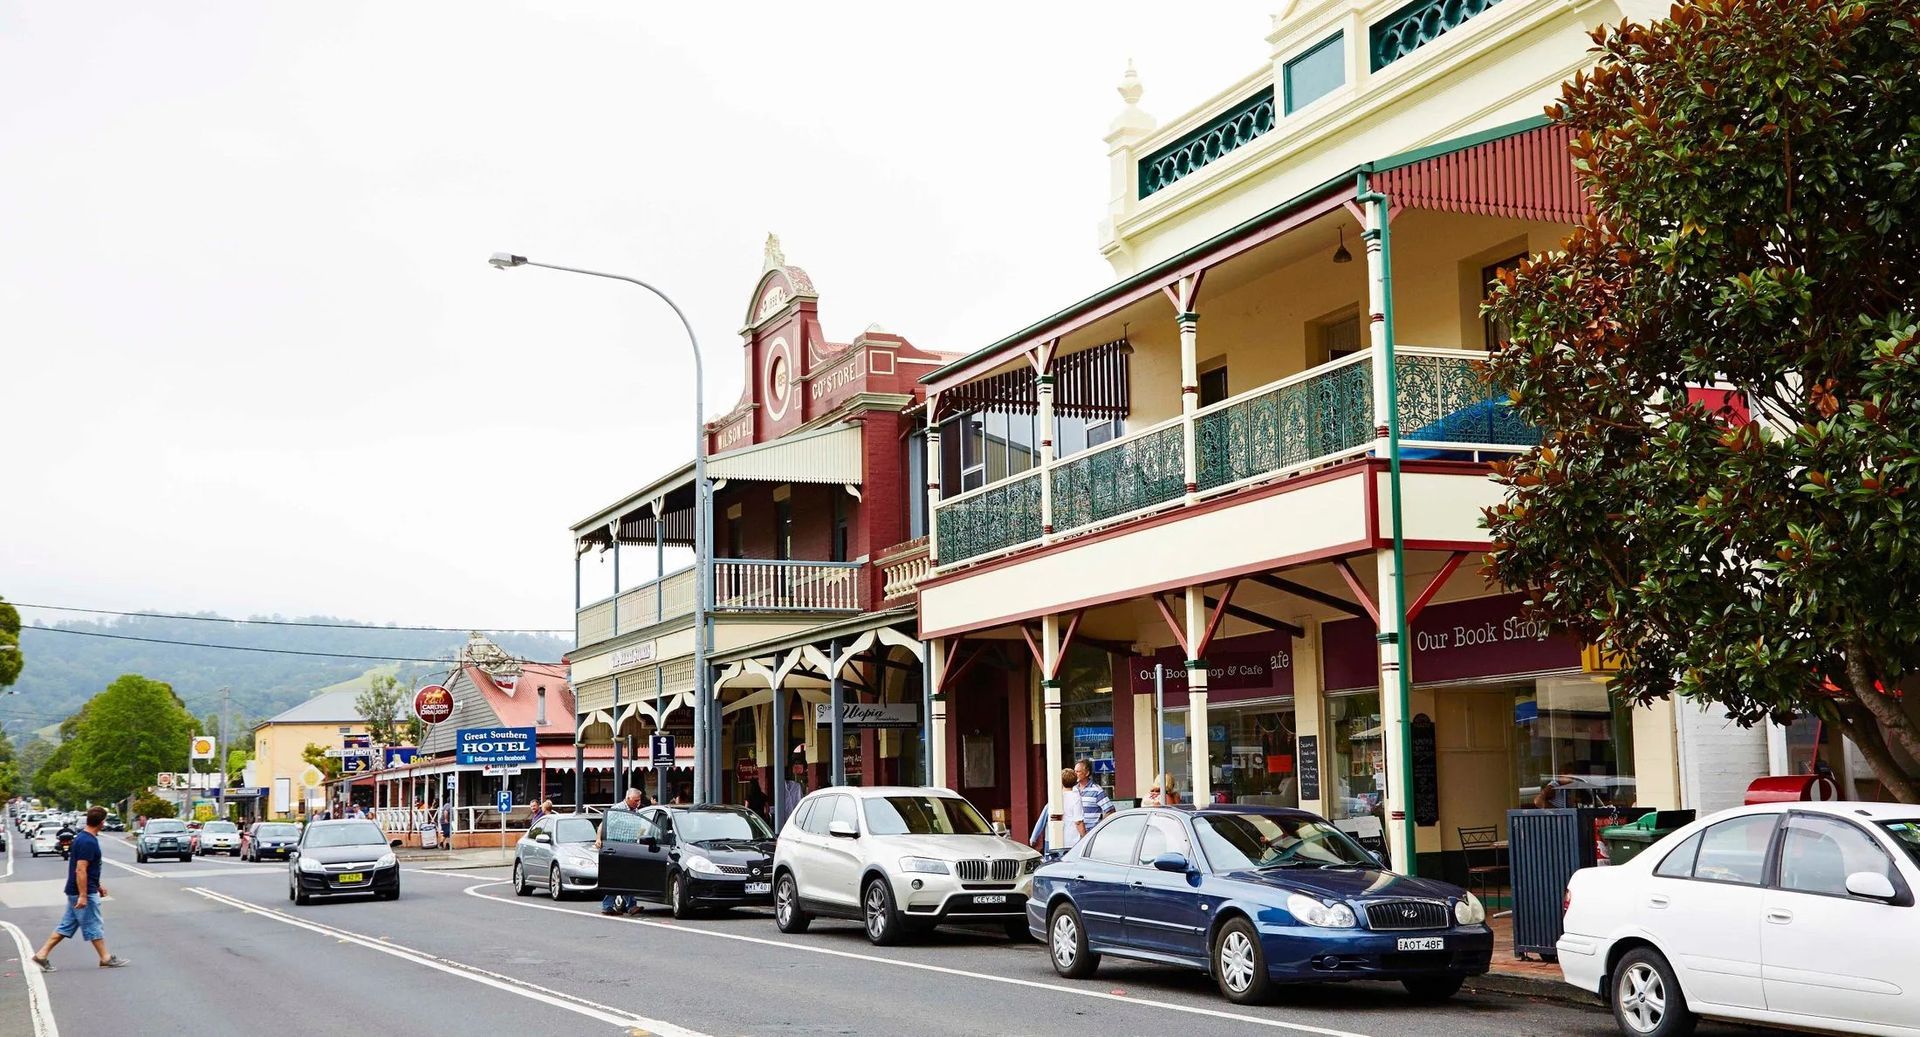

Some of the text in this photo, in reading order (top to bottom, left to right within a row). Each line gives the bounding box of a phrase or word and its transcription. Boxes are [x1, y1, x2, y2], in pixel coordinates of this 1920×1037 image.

[717, 424, 744, 451] WILSON
[827, 363, 855, 393] STORE
[1417, 631, 1448, 651] Our
[1453, 622, 1498, 649] Book
[1270, 650, 1289, 670] afe
[1140, 669, 1155, 680] Ou
[1165, 668, 1188, 679] Boo
[1227, 665, 1237, 676] &
[1239, 665, 1263, 675] Cafe
[842, 704, 883, 721] Utopia
[464, 730, 528, 741] Great Southern
[462, 741, 531, 753] HOTEL
[500, 793, 509, 803] P
